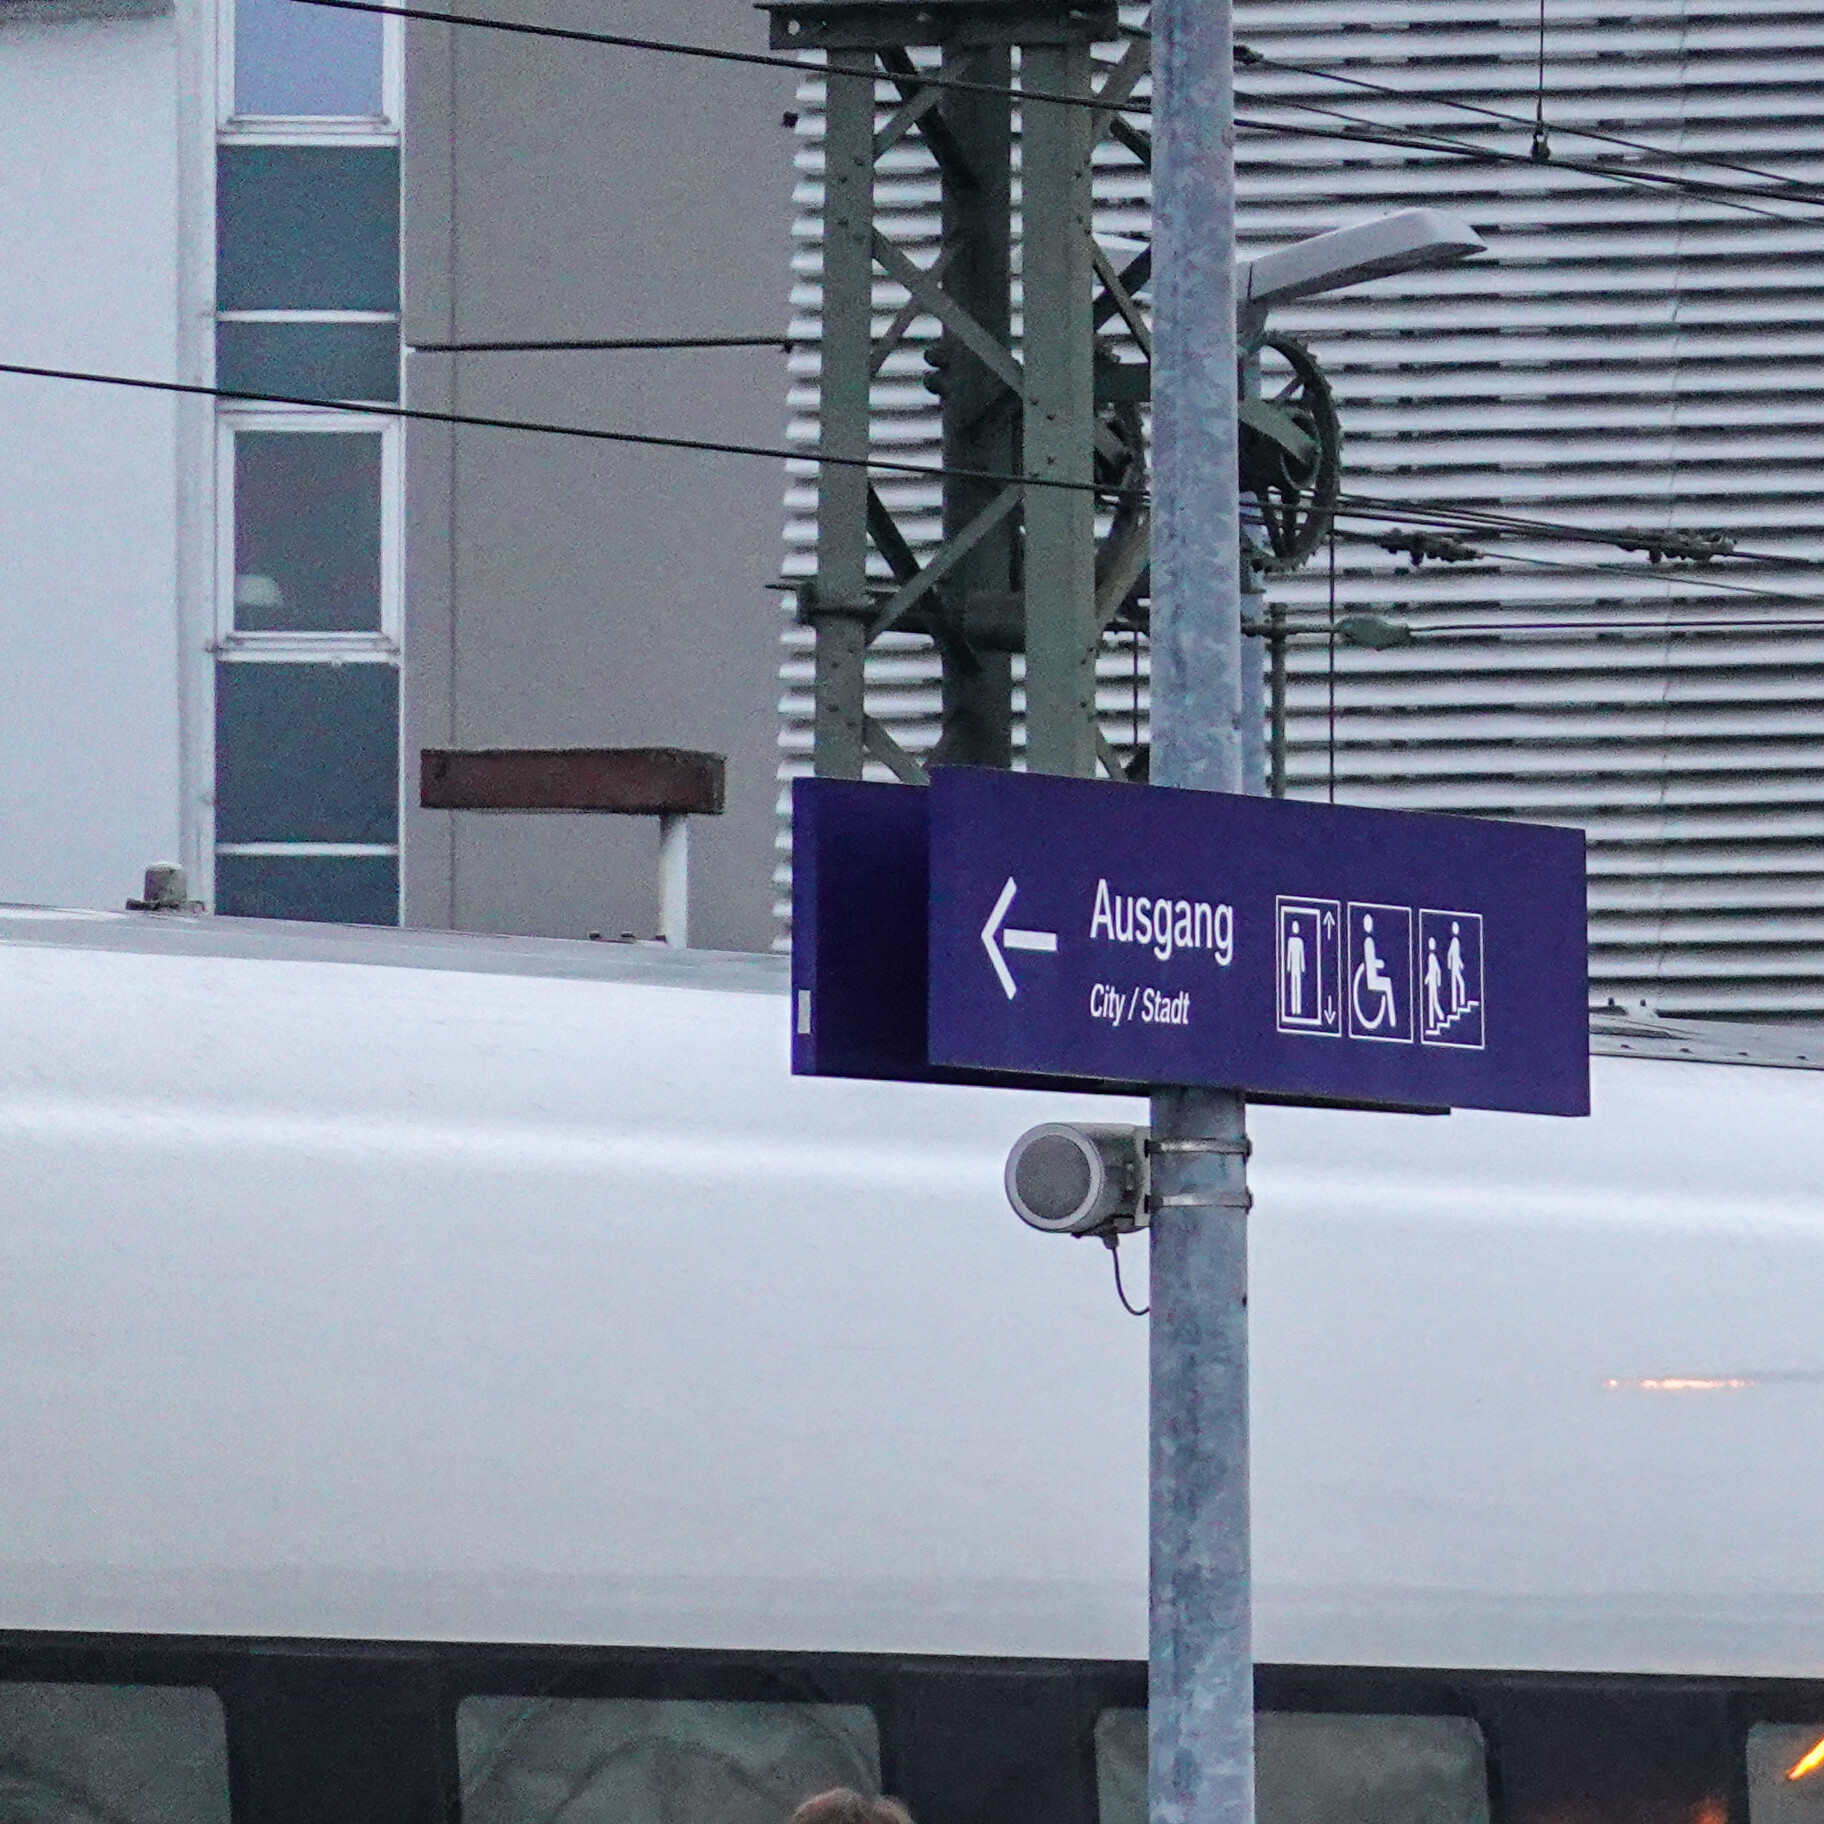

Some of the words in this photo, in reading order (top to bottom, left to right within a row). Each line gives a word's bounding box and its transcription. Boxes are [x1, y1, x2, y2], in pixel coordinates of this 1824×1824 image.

[1090, 878, 1233, 966] Ausgang
[1090, 983, 1125, 1026] City
[1127, 986, 1139, 1021] /
[1141, 987, 1190, 1024] Stadt
